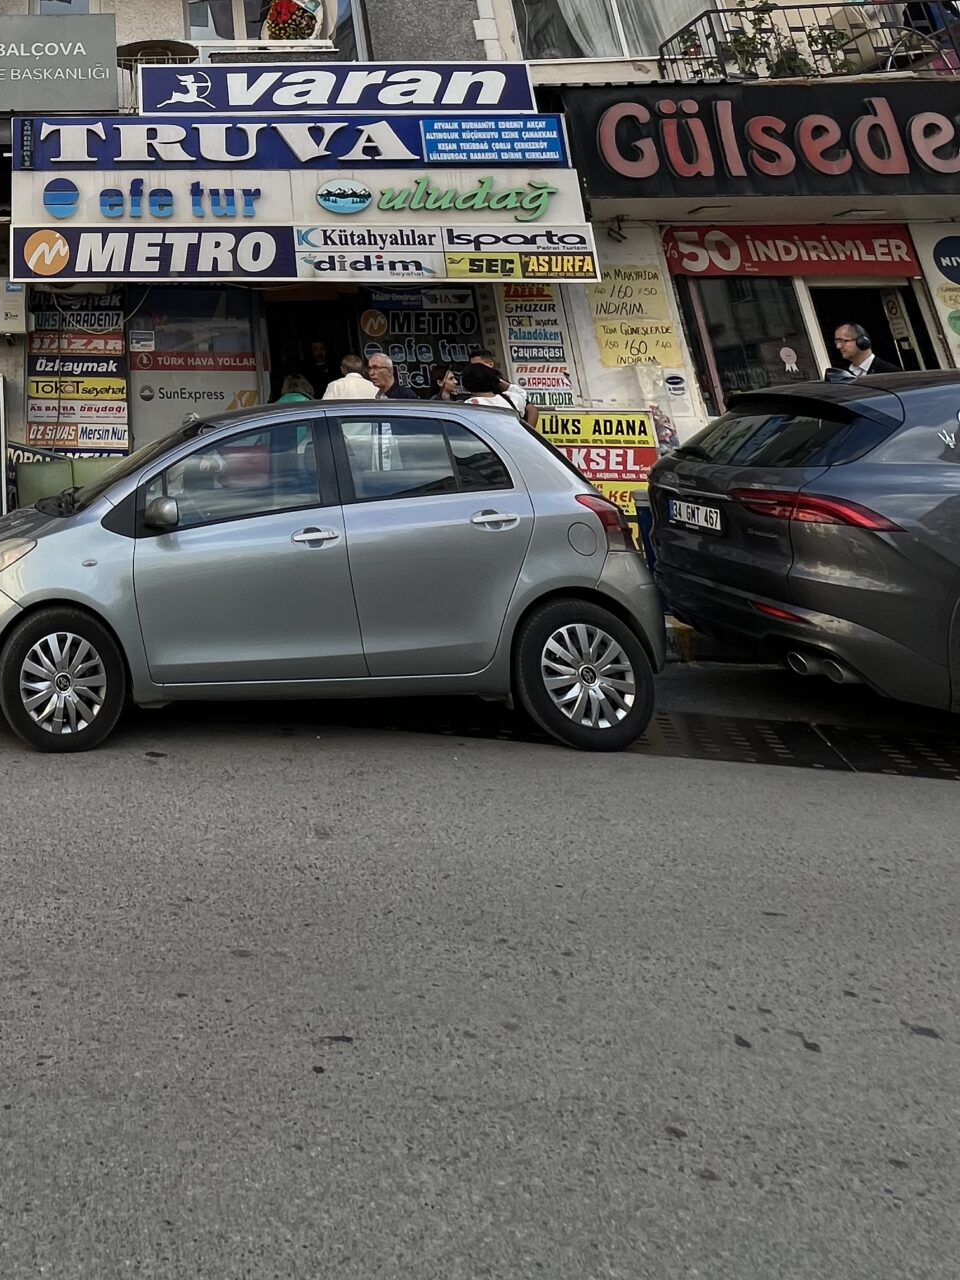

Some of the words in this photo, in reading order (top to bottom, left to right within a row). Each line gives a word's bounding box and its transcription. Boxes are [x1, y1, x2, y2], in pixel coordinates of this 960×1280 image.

[10, 60, 111, 83] BAŞKANLIĞI
[226, 70, 508, 106] varan
[40, 120, 420, 164] TRUVA
[99, 178, 172, 217] efe
[191, 180, 262, 217] tur
[378, 176, 560, 222] uludağ
[321, 228, 436, 250] Kütahyalılar
[745, 234, 912, 262] İNDİRİMLER
[74, 230, 278, 272] METRO
[313, 254, 424, 271] didim
[468, 257, 515, 276] SEÇ
[515, 303, 556, 313] HUZUR
[390, 310, 478, 335] METRO
[508, 328, 559, 341] Palandöken
[157, 355, 185, 366] TÜRK
[187, 356, 214, 366] HAVA
[217, 356, 256, 366] YOLLAR
[389, 337, 434, 362] efe
[35, 357, 118, 375] Özkaymak
[158, 387, 225, 402] SunExpress
[29, 423, 44, 439] ÖZ
[80, 426, 110, 440] Mersin
[542, 415, 581, 435] LÜKS
[592, 419, 648, 436] ADANA
[705, 508, 719, 530] 467
